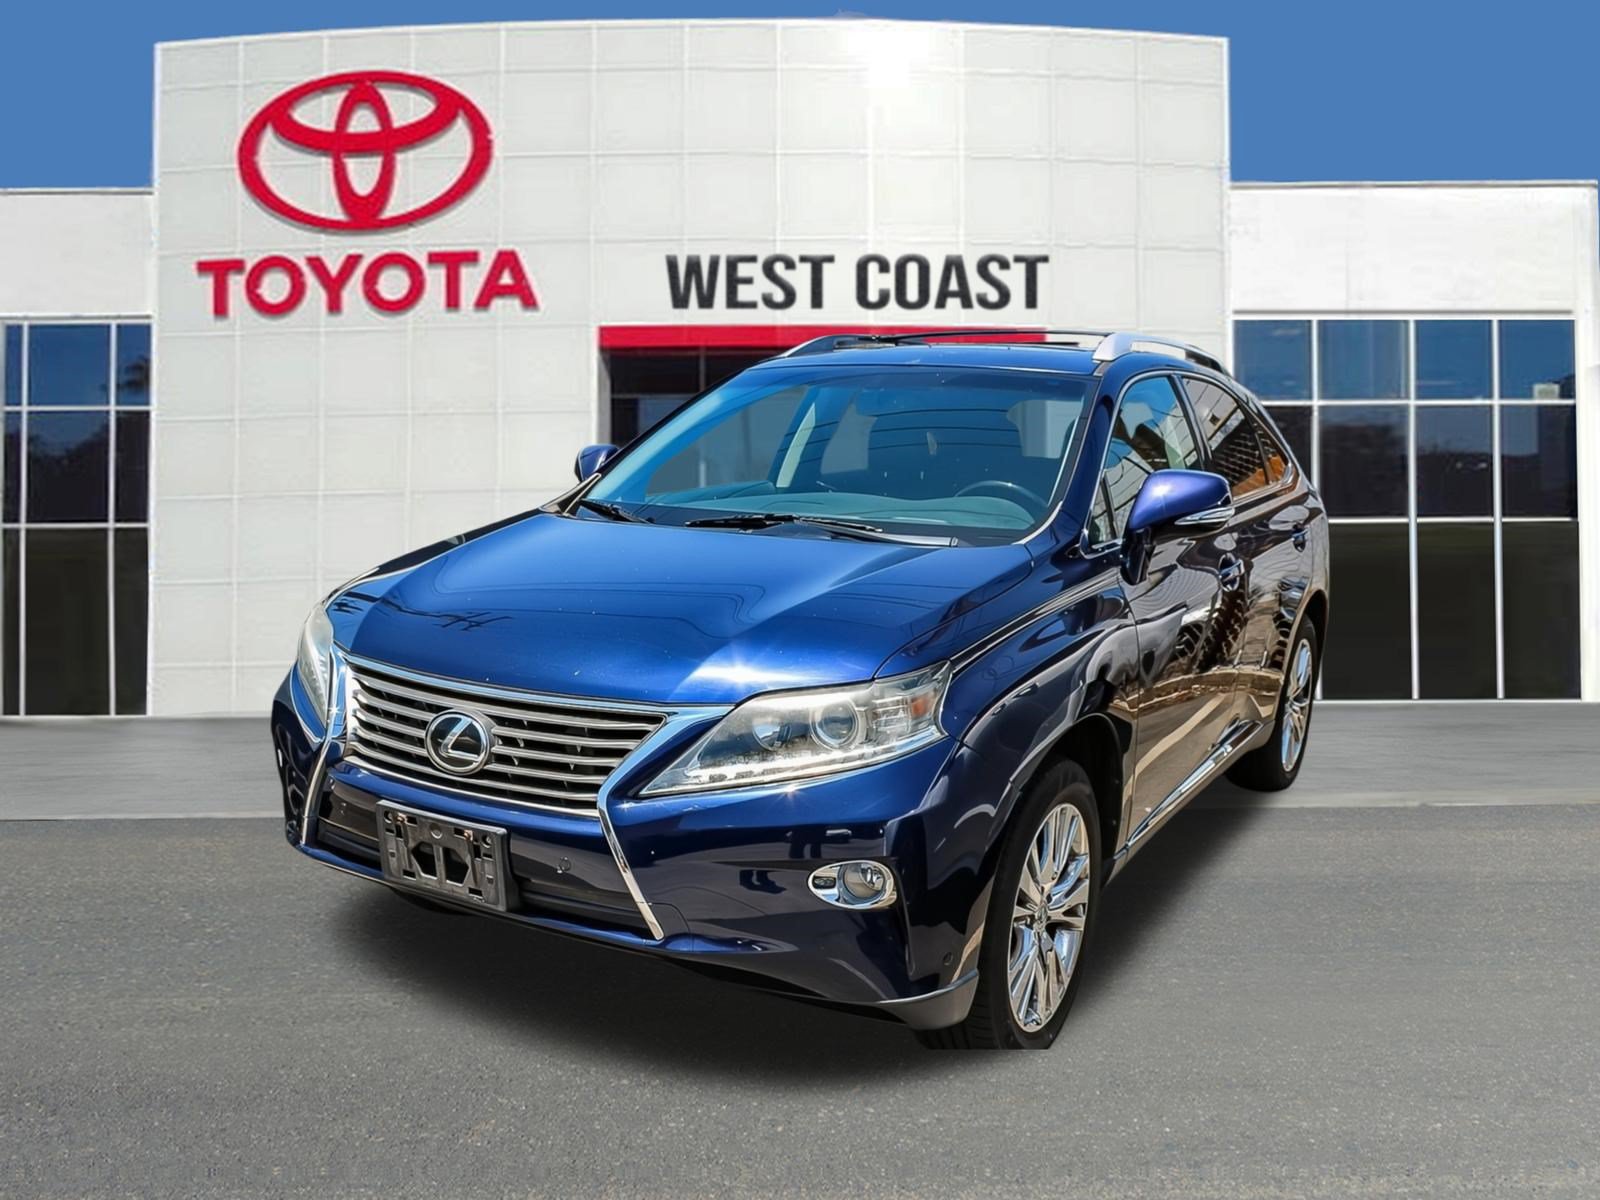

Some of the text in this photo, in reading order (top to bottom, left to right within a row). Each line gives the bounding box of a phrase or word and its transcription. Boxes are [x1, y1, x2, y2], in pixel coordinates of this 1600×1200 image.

[197, 250, 538, 317] TOYOTA
[667, 254, 1050, 310] WEST COAST
